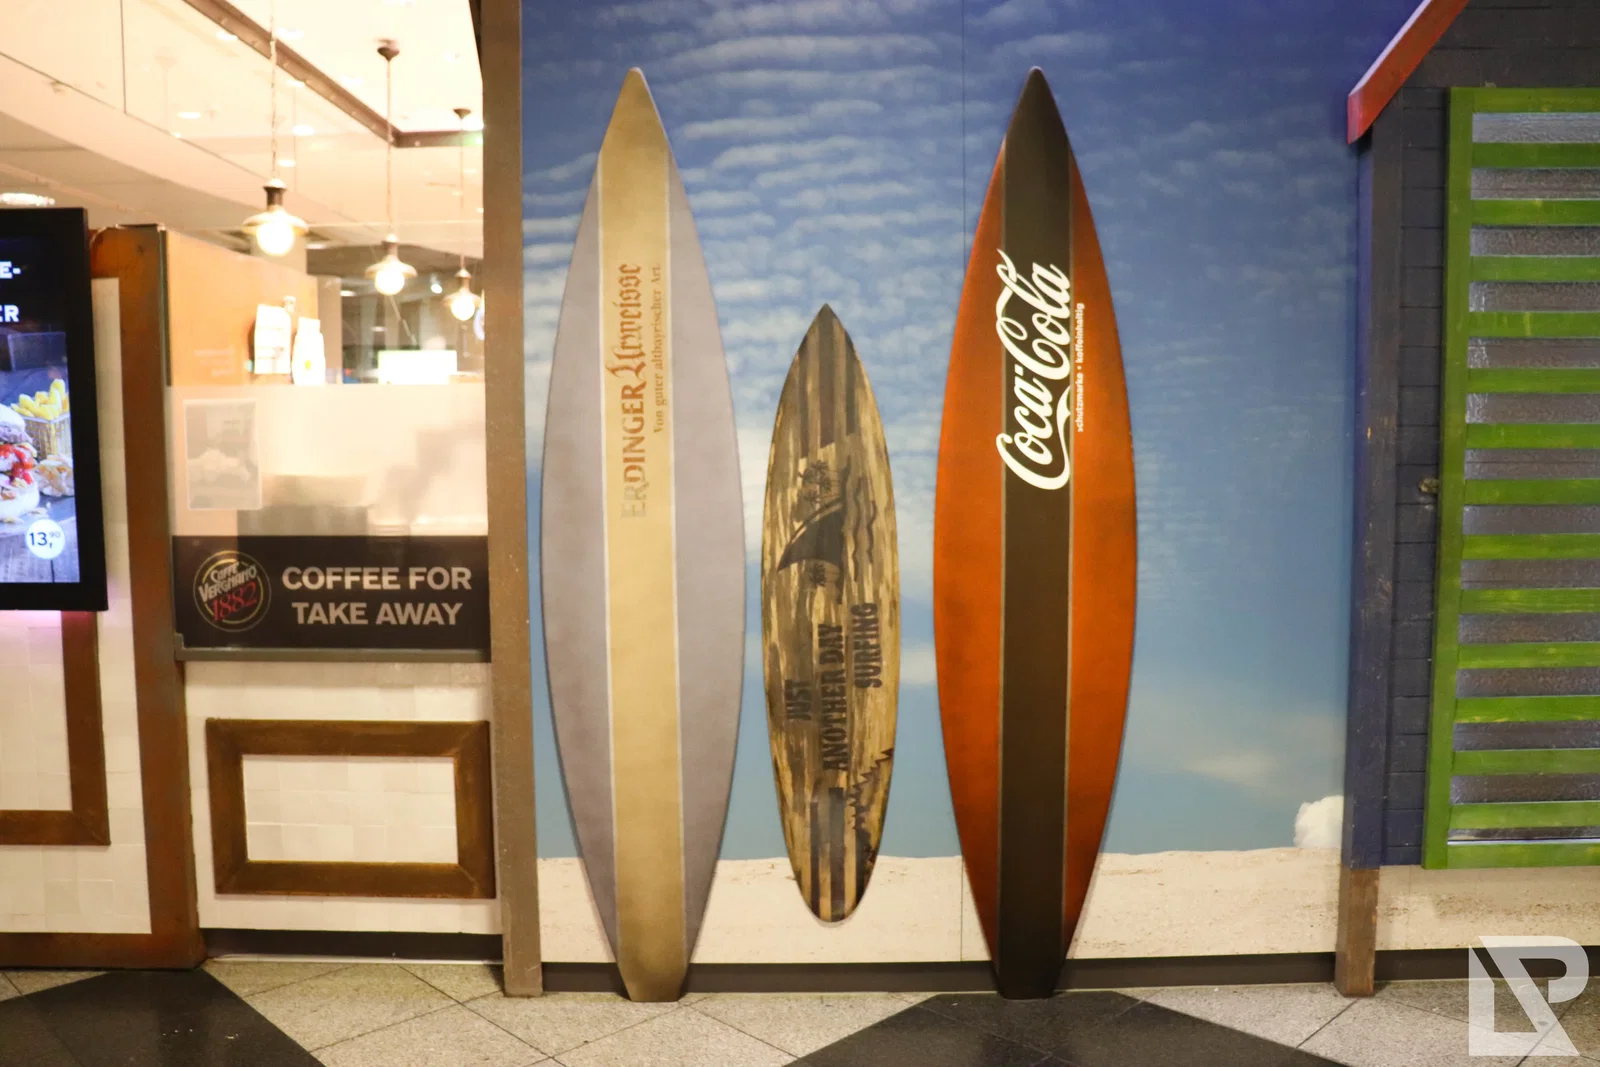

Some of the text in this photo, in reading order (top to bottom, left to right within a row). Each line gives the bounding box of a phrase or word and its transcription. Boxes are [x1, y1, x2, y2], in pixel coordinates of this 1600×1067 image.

[0, 304, 20, 323] R
[1074, 302, 1085, 364] koffeinhaltig
[995, 248, 1072, 491] Coca-Cola
[653, 374, 668, 407] guter
[653, 410, 664, 433] Von
[620, 380, 649, 518] ERDINGER
[281, 566, 472, 591] COFFEE FOR
[213, 581, 257, 621] 1882
[291, 602, 463, 626] TAKE AWAY
[850, 602, 882, 689] SURFING
[784, 679, 812, 721] JUST
[818, 623, 848, 772] ANOTHER DAY
